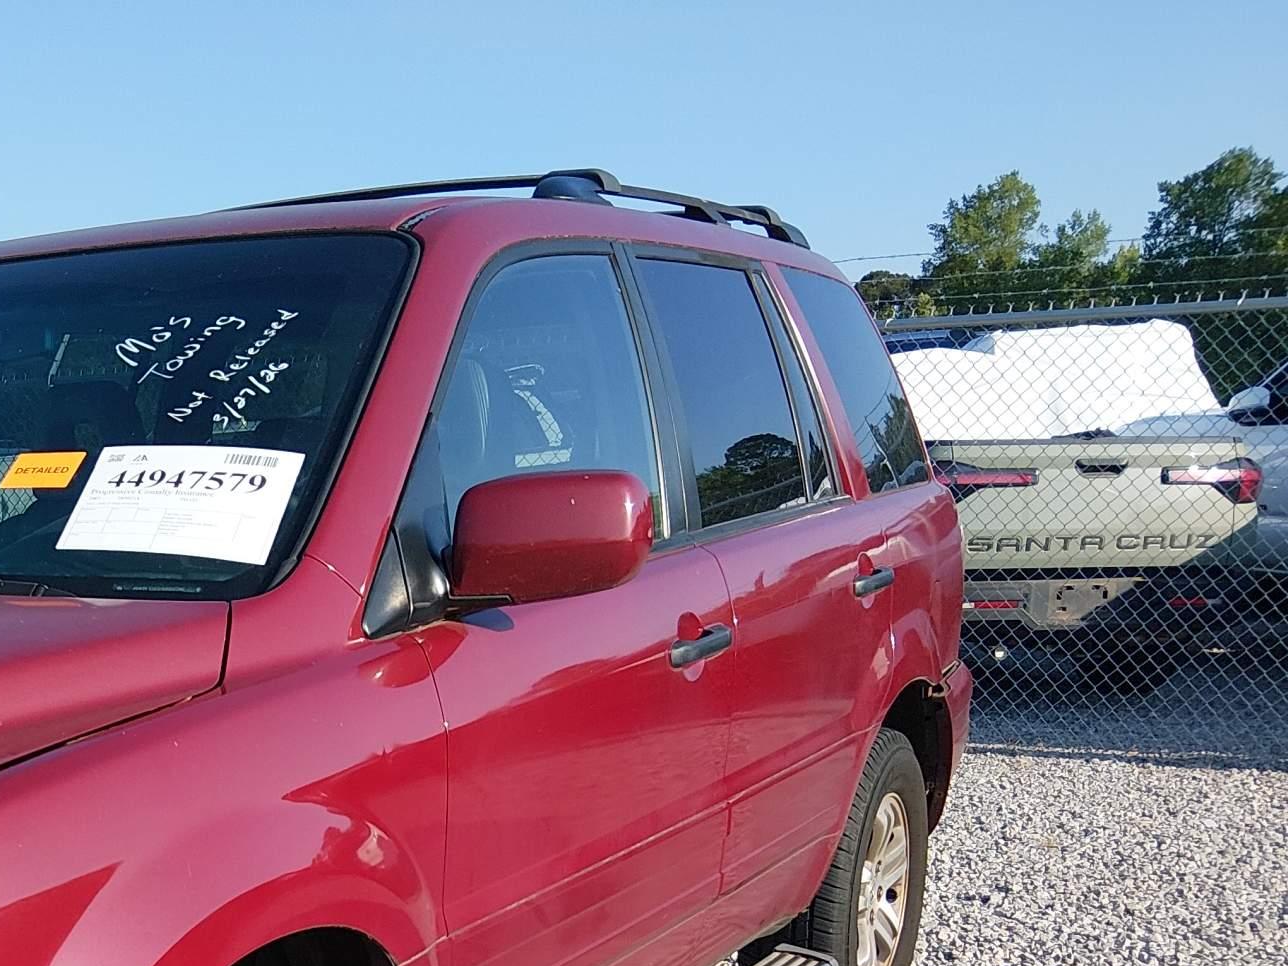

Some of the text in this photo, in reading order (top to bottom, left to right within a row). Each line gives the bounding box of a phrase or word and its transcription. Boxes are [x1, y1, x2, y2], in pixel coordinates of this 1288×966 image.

[137, 315, 246, 384] Towing
[168, 309, 300, 422] Not Released
[14, 466, 70, 475] DETAILED
[108, 469, 268, 495] 44947579
[967, 533, 1218, 553] SANTA CRUZ
